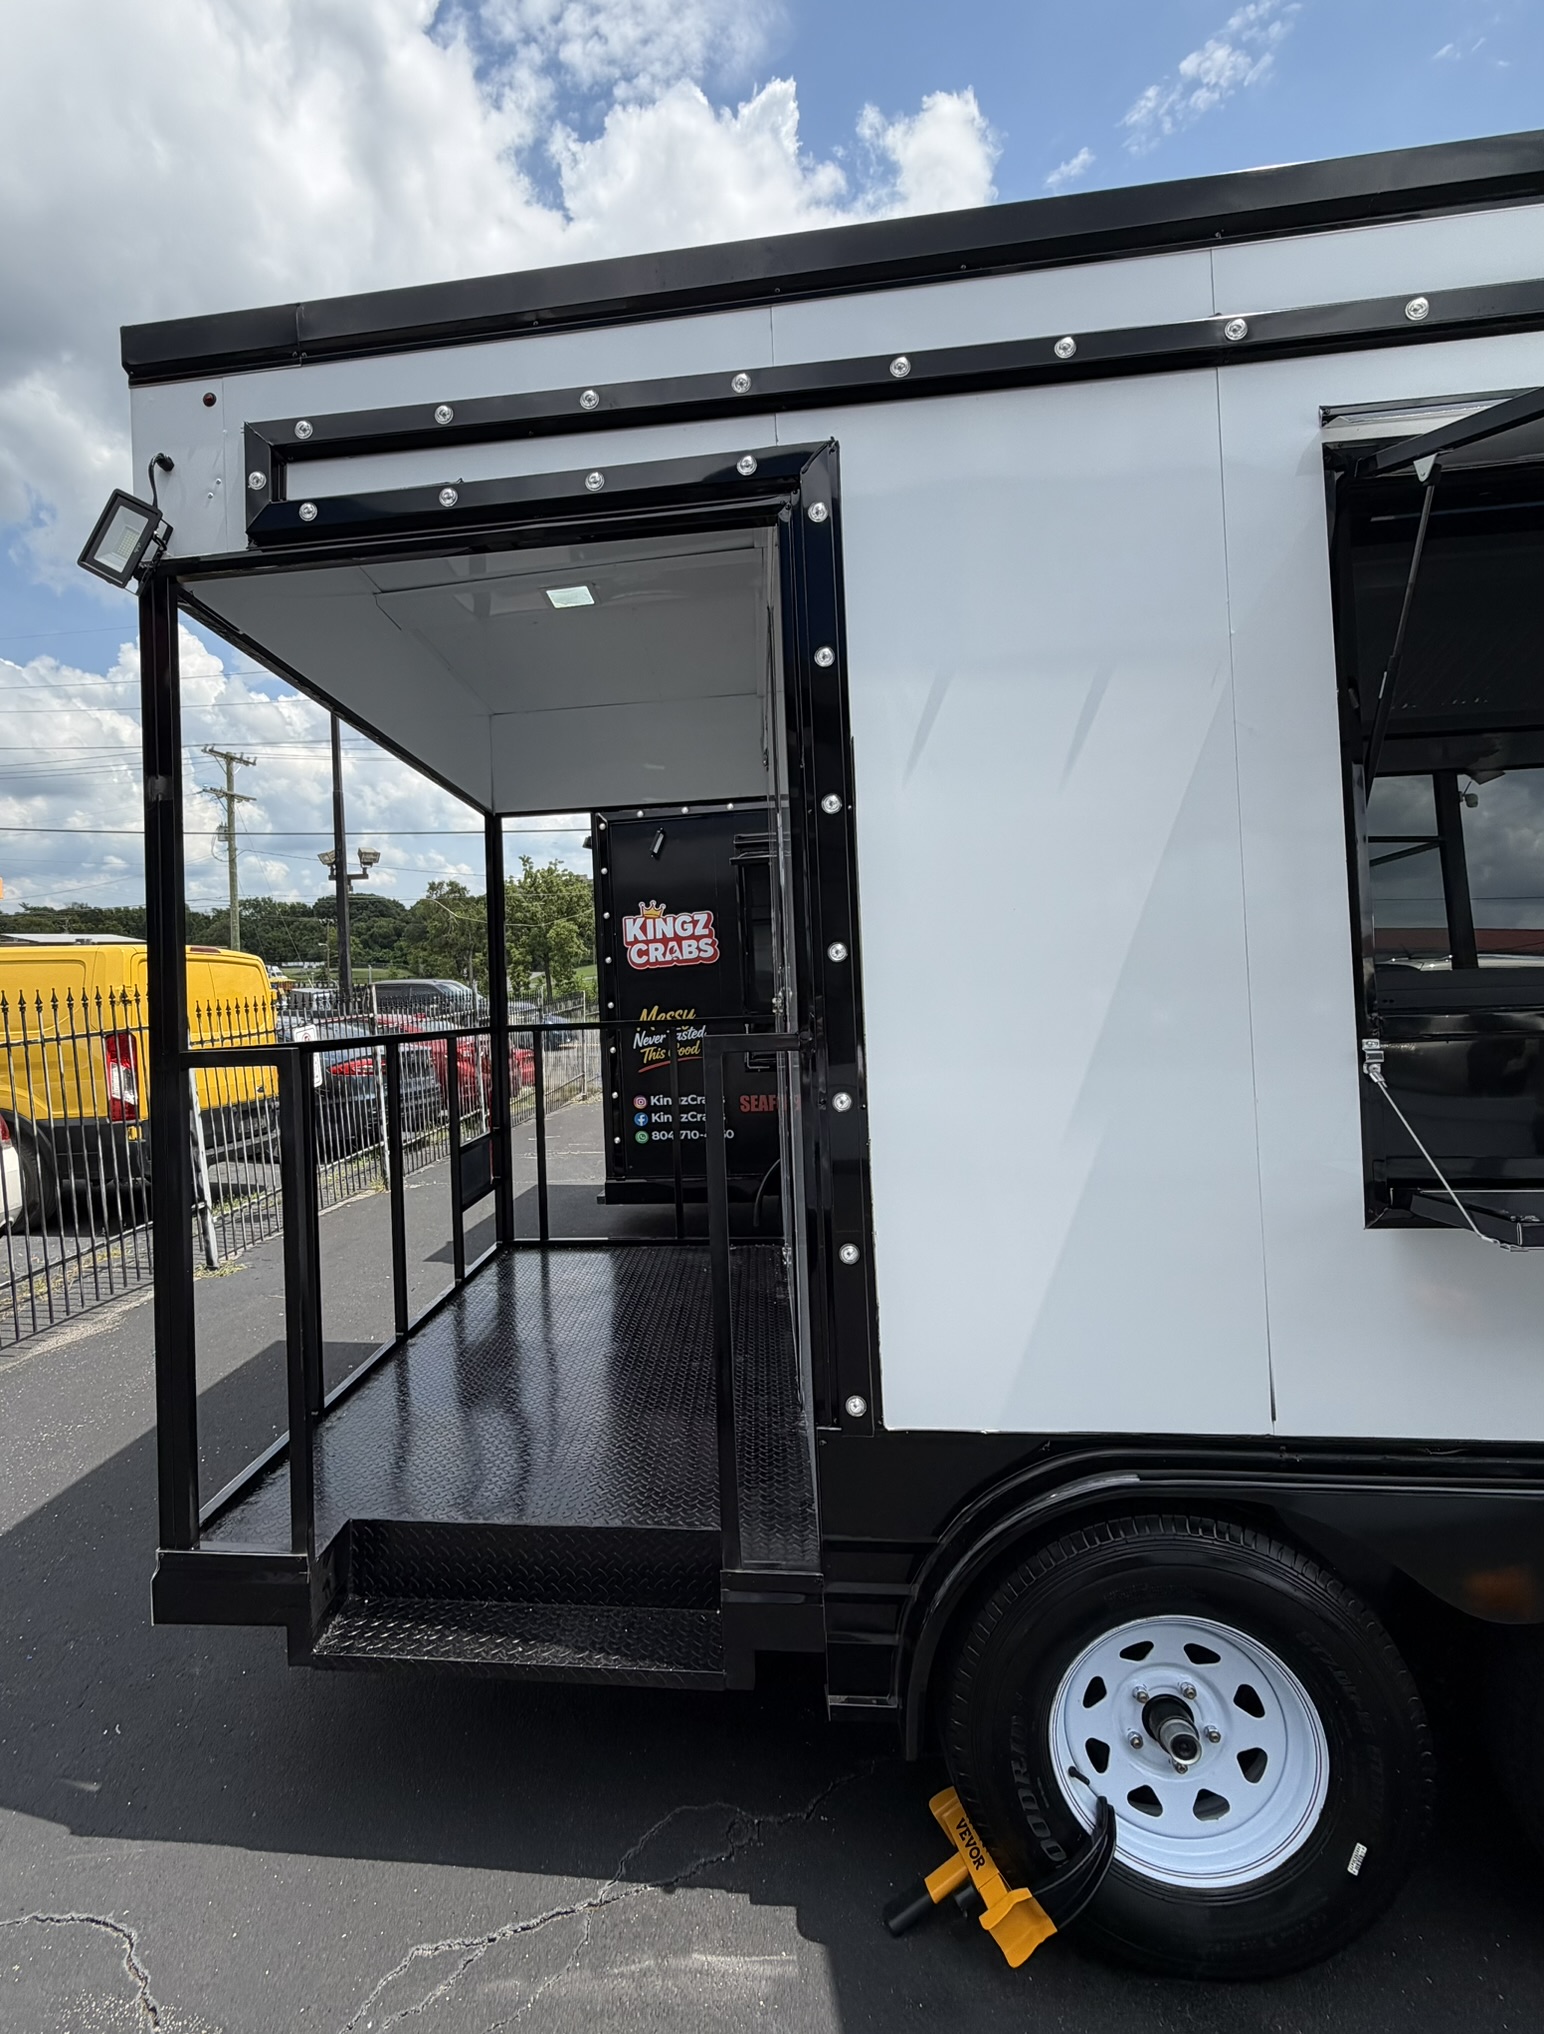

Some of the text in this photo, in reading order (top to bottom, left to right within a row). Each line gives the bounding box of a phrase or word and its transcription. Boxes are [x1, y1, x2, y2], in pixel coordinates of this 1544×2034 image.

[625, 913, 709, 942] KINGZ
[630, 938, 714, 964] CRABS
[632, 1024, 708, 1050] Never asted
[640, 1046, 667, 1064] This
[955, 1816, 986, 1871] VEVOR
